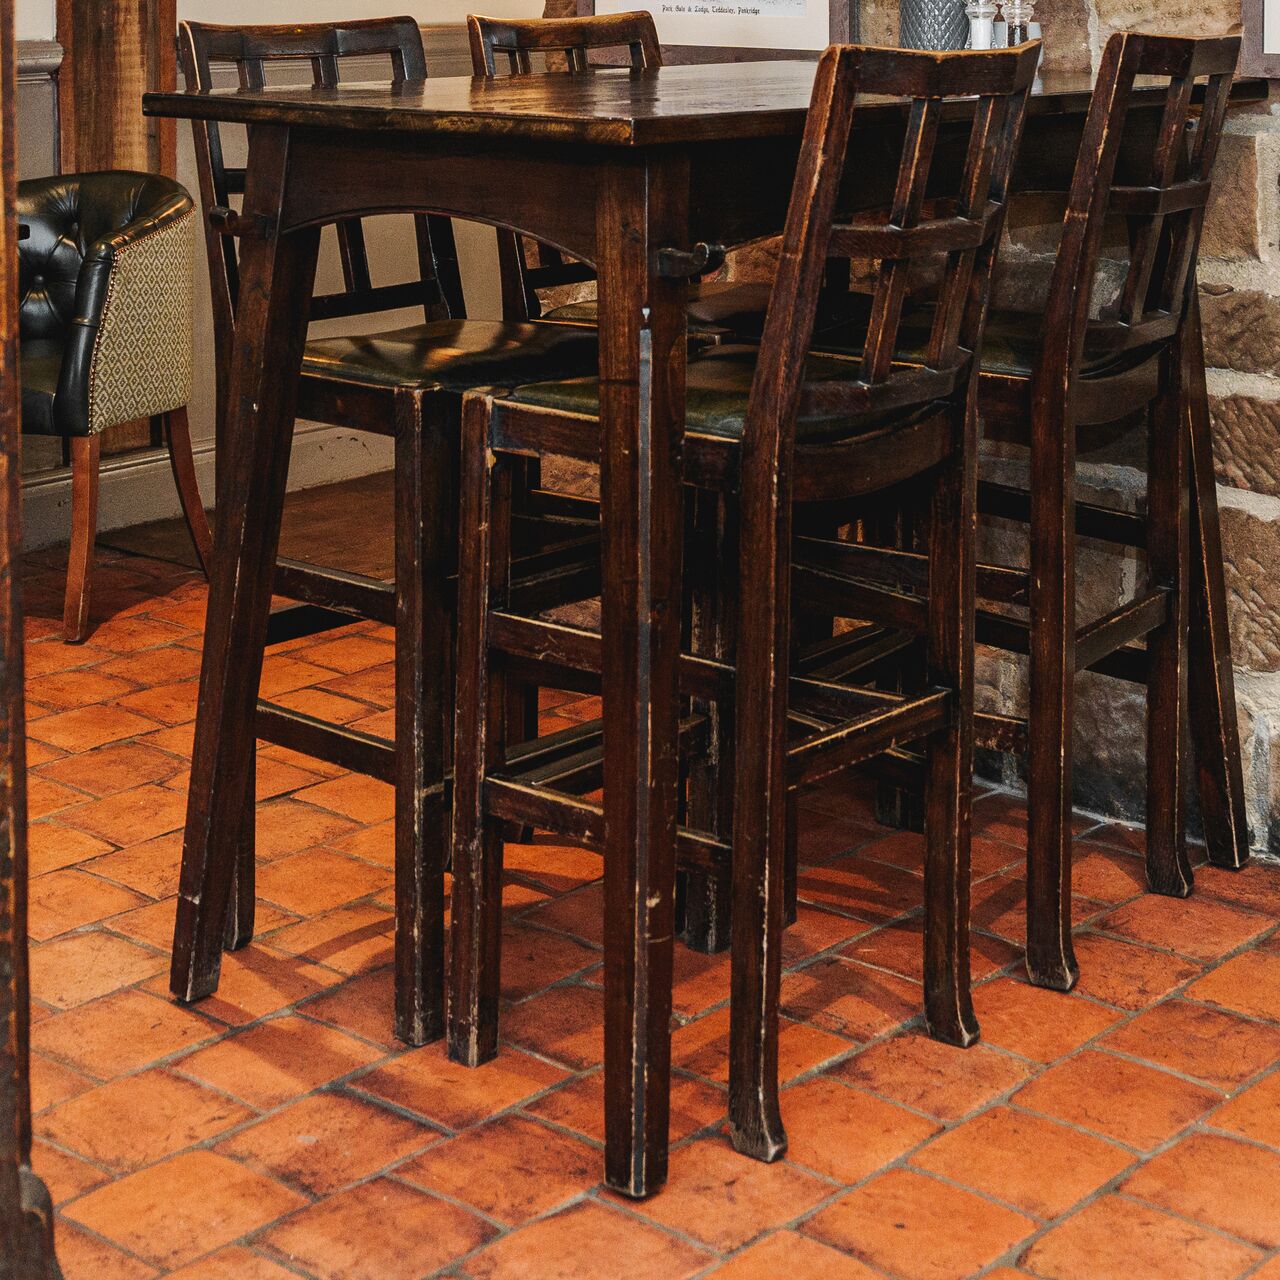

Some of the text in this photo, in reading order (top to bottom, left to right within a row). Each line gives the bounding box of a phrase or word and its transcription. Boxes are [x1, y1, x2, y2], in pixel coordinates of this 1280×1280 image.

[662, 4, 673, 13] Park
[711, 6, 736, 15] Teddesley,
[737, 6, 761, 16] Penkridge
